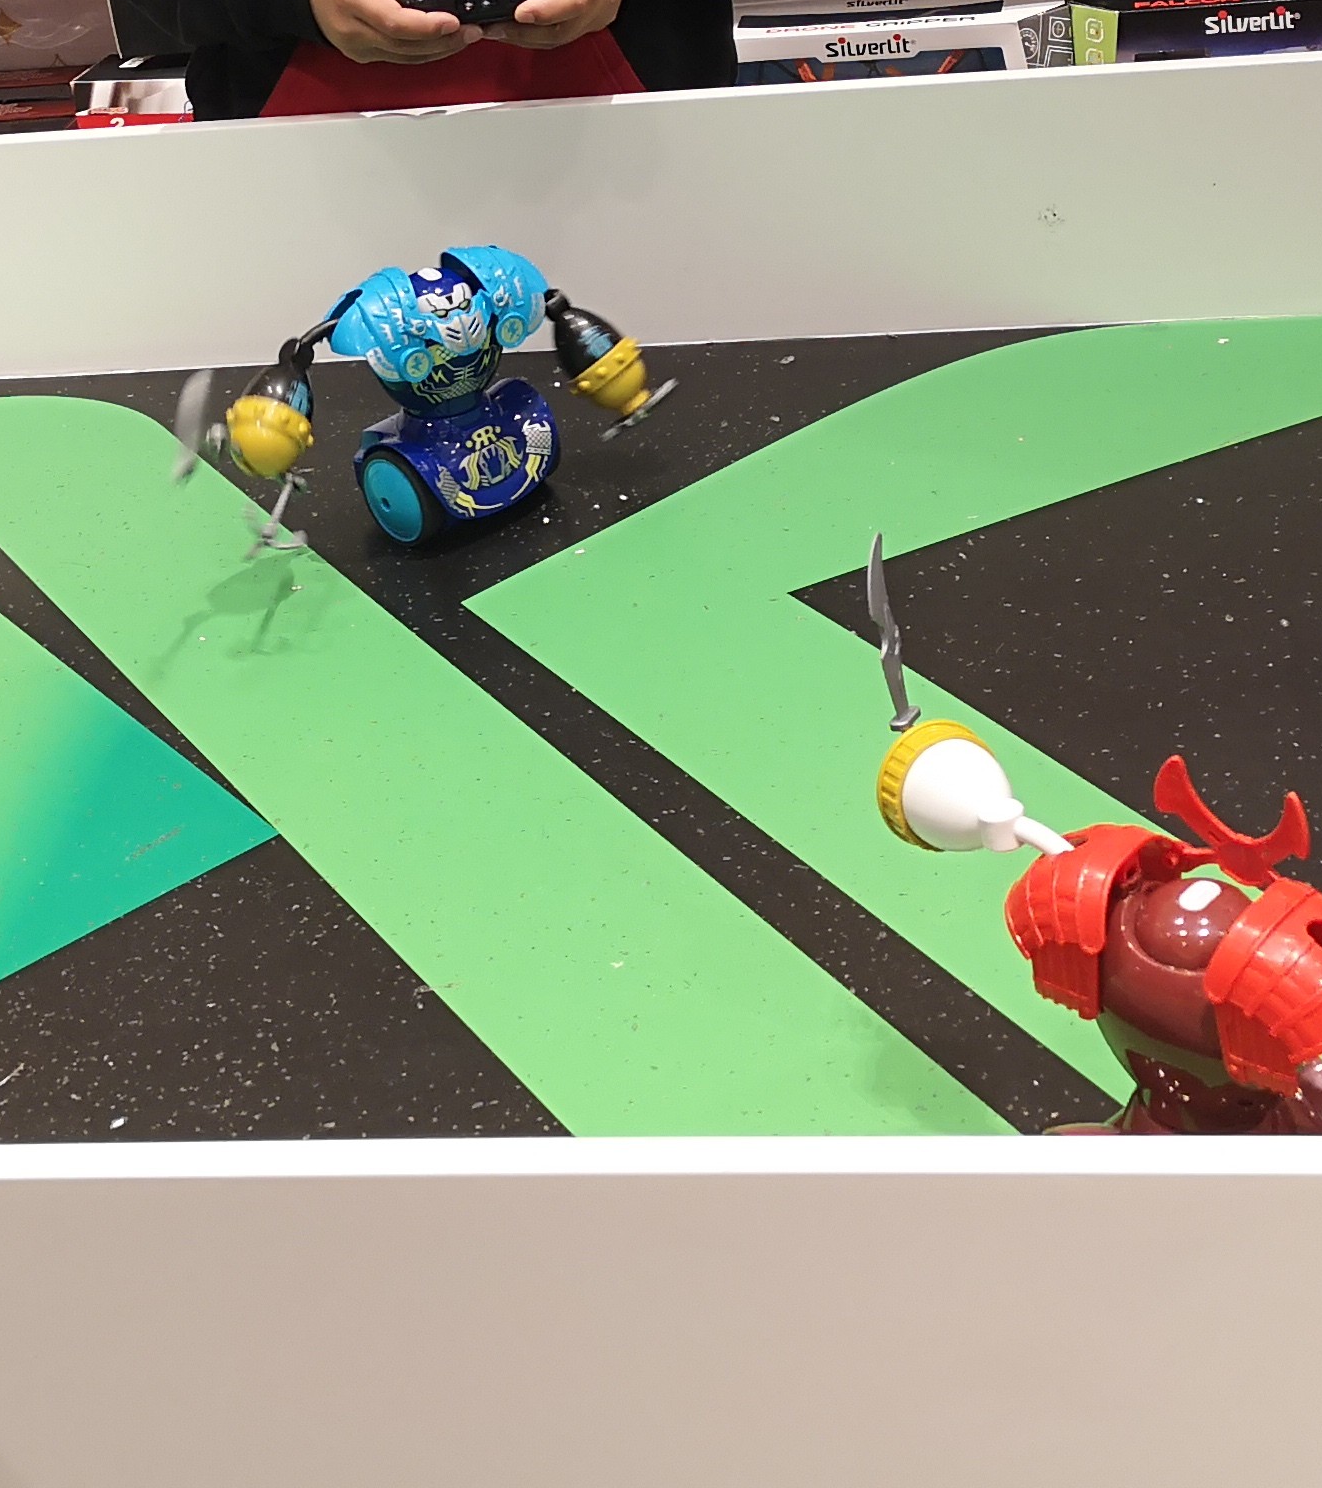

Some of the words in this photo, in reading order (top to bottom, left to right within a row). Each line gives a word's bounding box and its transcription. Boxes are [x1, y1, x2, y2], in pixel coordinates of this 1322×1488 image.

[765, 23, 856, 34] DRONE
[865, 15, 977, 28] GRIPPER
[1204, 7, 1301, 36] Silverlit
[824, 33, 916, 58] Silverlit
